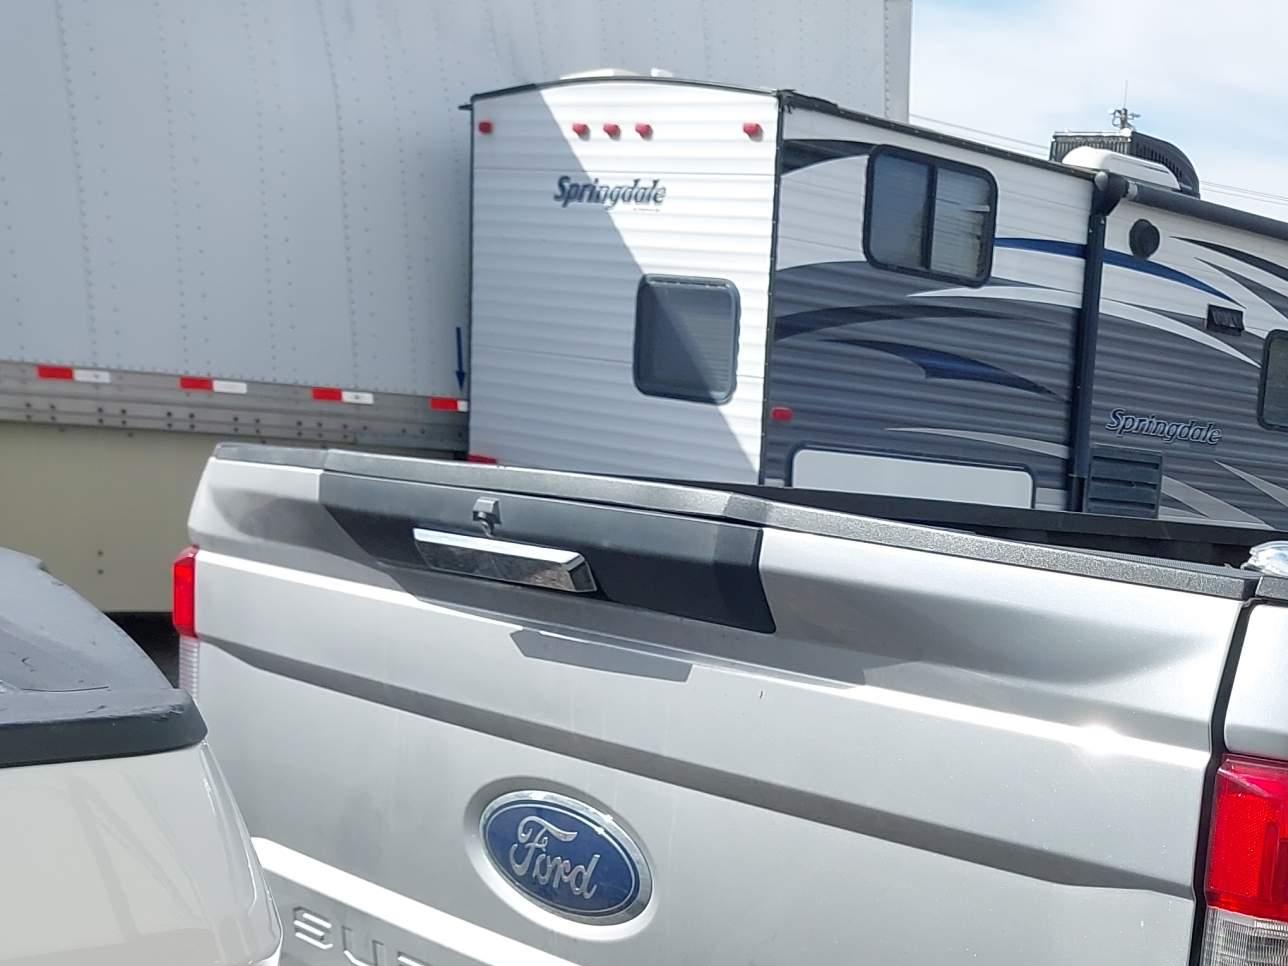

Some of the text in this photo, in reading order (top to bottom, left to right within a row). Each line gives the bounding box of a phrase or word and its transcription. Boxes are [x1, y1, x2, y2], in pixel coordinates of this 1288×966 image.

[553, 175, 666, 210] Springdale
[1105, 407, 1222, 445] Springdale
[508, 814, 601, 900] Ford
